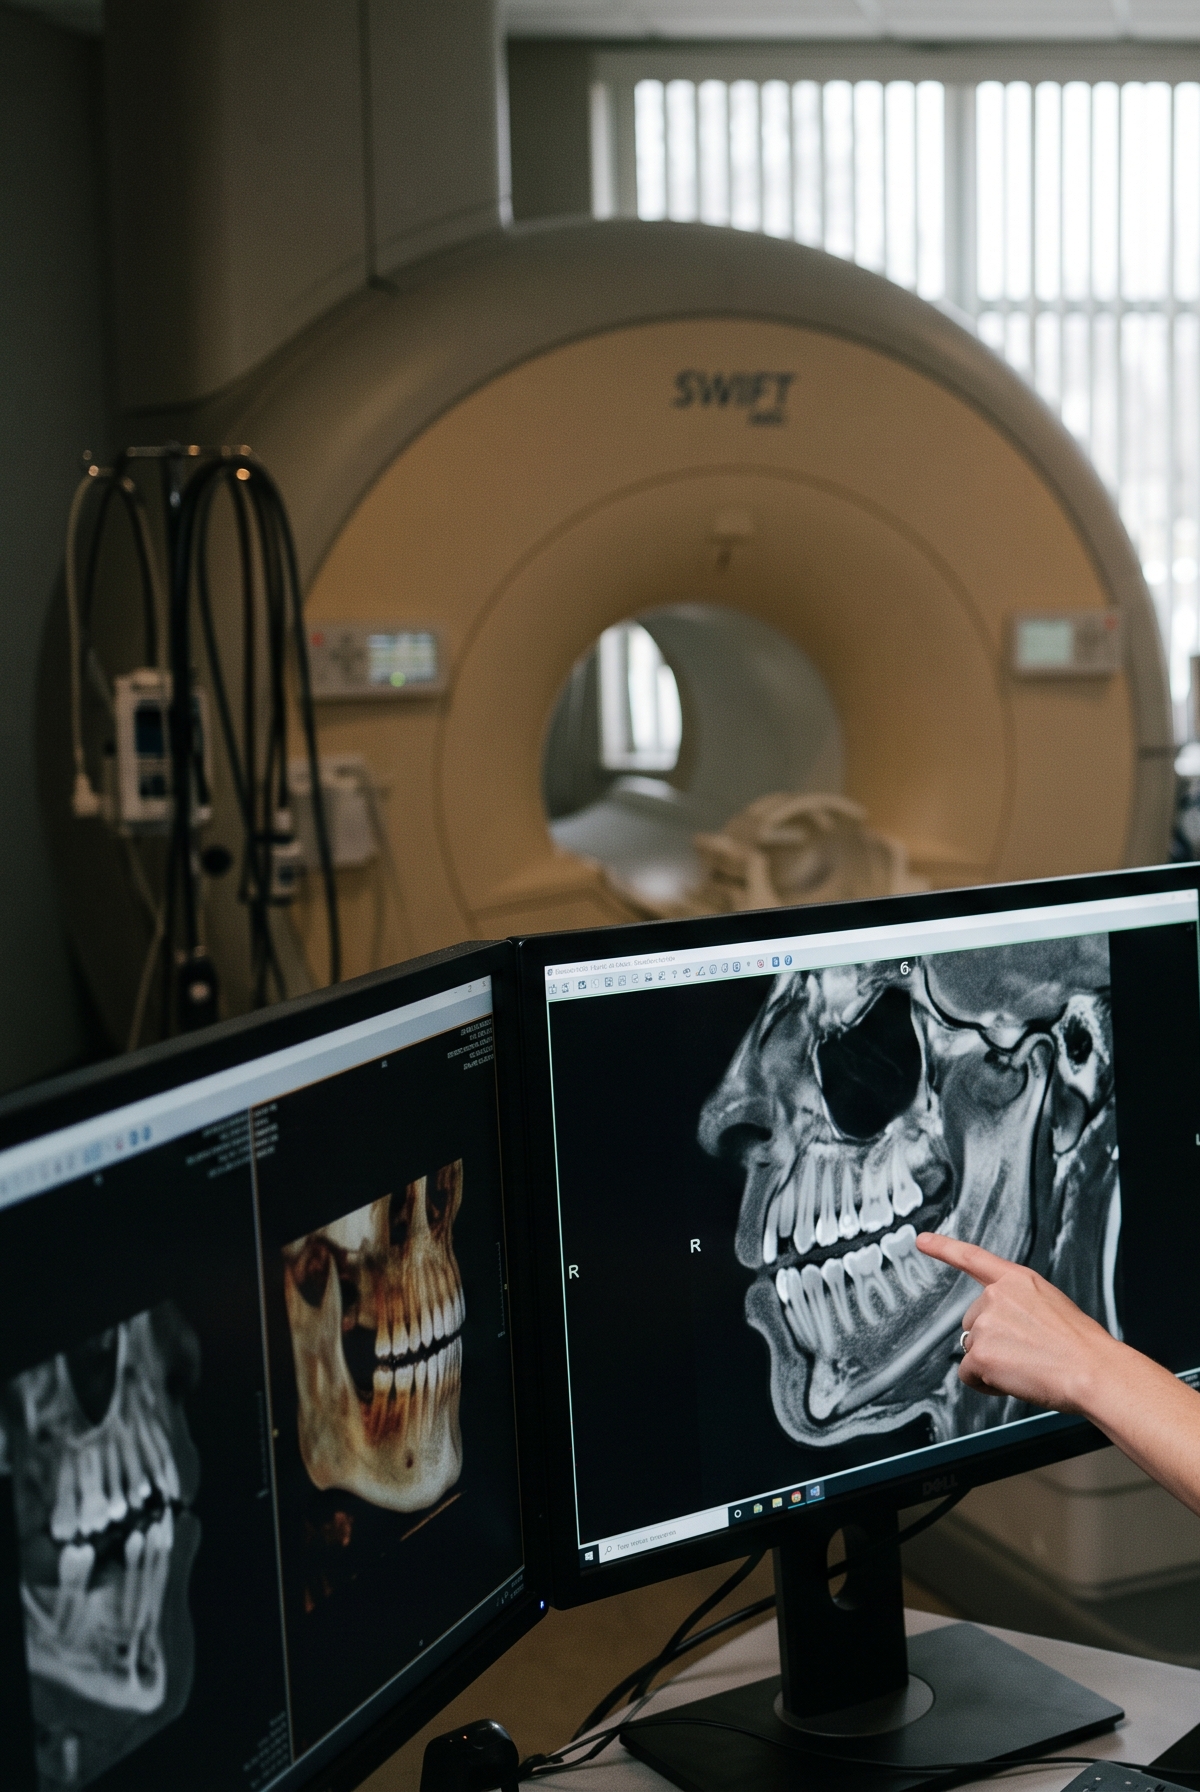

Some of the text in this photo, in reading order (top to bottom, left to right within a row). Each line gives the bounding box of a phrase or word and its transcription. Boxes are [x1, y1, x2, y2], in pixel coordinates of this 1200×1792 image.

[690, 1238, 701, 1253] R
[568, 1264, 579, 1279] R
[922, 1474, 958, 1496] DELL
